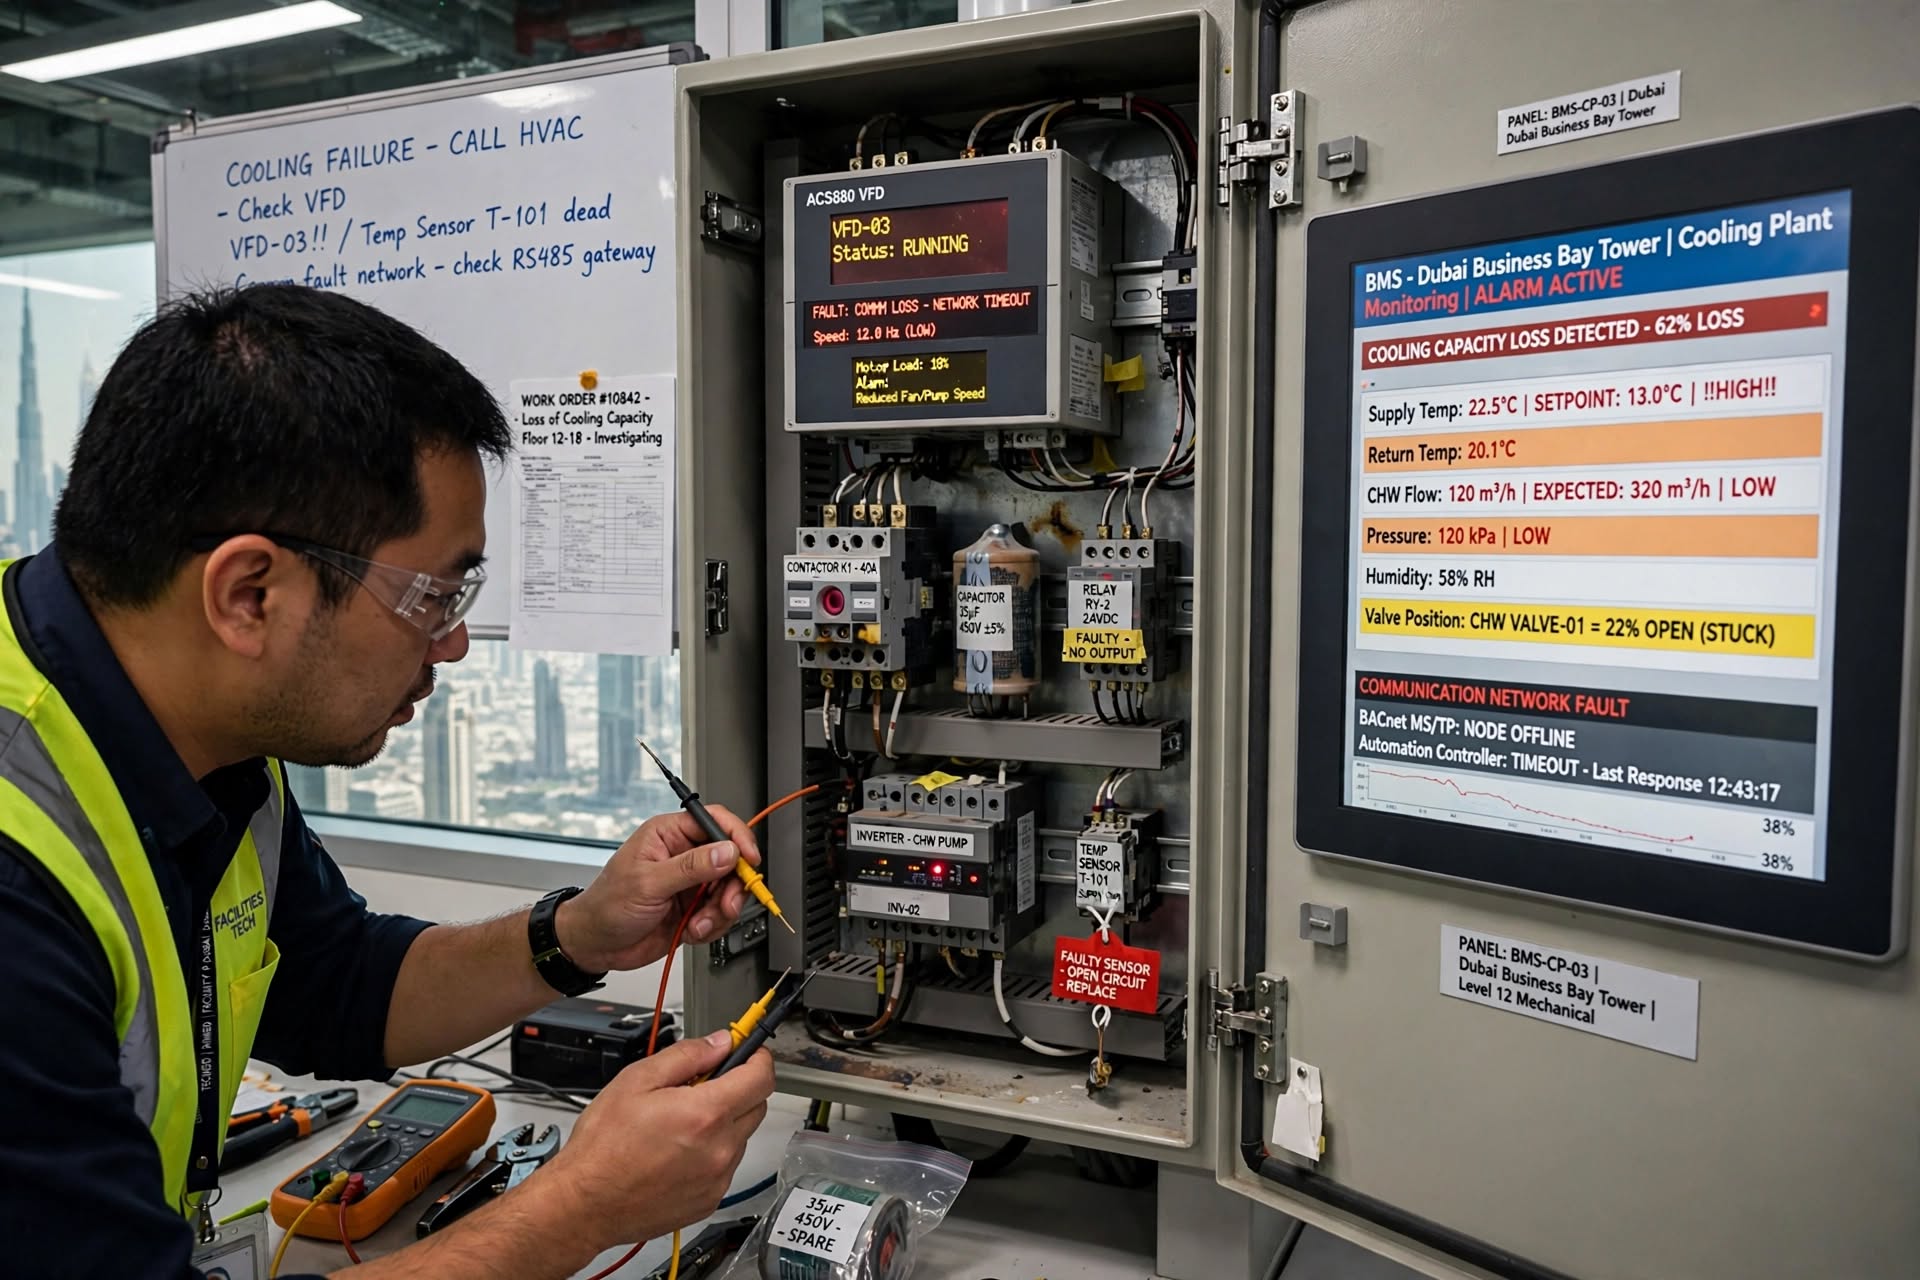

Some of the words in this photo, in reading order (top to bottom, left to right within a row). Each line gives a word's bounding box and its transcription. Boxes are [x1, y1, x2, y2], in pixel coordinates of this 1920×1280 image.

[1508, 110, 1548, 128] PANEL:
[1552, 93, 1616, 119] BMS-CP-03
[1627, 82, 1665, 102] Dubai
[1506, 127, 1537, 145] Dubai
[1541, 118, 1590, 138] Business
[1594, 113, 1615, 127] Bay
[1618, 105, 1656, 121] Tower
[226, 152, 312, 187] COOLING
[327, 136, 414, 171] FAILURE
[449, 126, 506, 155] CALL
[520, 116, 584, 144] HVAC
[238, 193, 293, 223] Check
[304, 187, 346, 213] VFD
[806, 189, 855, 207] ACS880
[859, 186, 885, 201] VFD
[230, 224, 327, 261] VFD-03!!
[361, 222, 406, 251] Temp
[417, 215, 475, 239] Sensor
[486, 202, 546, 230] T-101
[564, 193, 611, 221] dead
[832, 216, 890, 238] VFD-03
[832, 243, 895, 262] Status:
[903, 234, 969, 257] RUNNING
[1366, 269, 1402, 293] BMS
[1418, 259, 1467, 285] Dubai
[1473, 251, 1551, 278] Business
[1558, 244, 1593, 269] Bay
[1598, 235, 1661, 260] Tower
[1678, 219, 1763, 249] Cooling
[1770, 206, 1833, 237] Plant
[304, 264, 347, 289] fault
[358, 260, 425, 285] network
[453, 249, 503, 276] check
[513, 243, 574, 271] RS485
[583, 242, 656, 276] gateway
[1365, 289, 1458, 319] Monitoring
[1474, 276, 1543, 305] ALARM
[1548, 265, 1623, 295] ACTIVE
[813, 304, 849, 319] FAULT:
[892, 299, 919, 315] LOSS
[933, 295, 979, 312] NETWORK
[984, 292, 1031, 308] TIMEOUT
[813, 330, 849, 345] Speed:
[857, 326, 882, 340] 12.0
[886, 325, 899, 338] Hz
[905, 322, 936, 339] (LOW)
[1368, 342, 1431, 364] COOLING
[1434, 333, 1508, 357] CAPACITY
[1510, 328, 1550, 350] LOSS
[1554, 319, 1639, 345] DETECTED
[1655, 313, 1692, 335] 62%
[1697, 307, 1744, 331] LOSS
[856, 360, 889, 374] Motor
[893, 358, 923, 372] Load:
[930, 357, 949, 370] 18%
[856, 377, 889, 389] Alarm:
[521, 394, 555, 407] WORK
[559, 393, 596, 406] ORDER
[599, 391, 641, 405] #10842
[856, 390, 898, 404] Reduced
[901, 388, 949, 403] Fan/Pump
[954, 386, 985, 401] Speed
[1368, 402, 1415, 426] Supply
[1420, 402, 1462, 422] Temp:
[1468, 396, 1517, 416] 22.5°C
[1535, 389, 1620, 411] SETPOINT:
[1628, 384, 1682, 405] 13.0°C
[1704, 376, 1776, 400] !!HIGH!!
[522, 413, 545, 426] Loss
[549, 411, 561, 425] of
[563, 410, 603, 428] Cooling
[607, 410, 653, 428] Capacity
[522, 431, 548, 445] Floor
[552, 431, 582, 445] 12-18
[595, 430, 663, 447] Investigating
[1368, 446, 1414, 464] Return
[1419, 444, 1462, 465] Temp:
[1467, 439, 1516, 459] 20.1°C
[1367, 486, 1400, 504] CHW
[1405, 485, 1442, 503] Flow:
[1449, 484, 1475, 502] 120
[1479, 482, 1516, 503] m³/h
[1534, 481, 1623, 501] EXPECTED:
[1630, 479, 1662, 499] 320
[1667, 477, 1710, 500] m³/h
[1731, 476, 1776, 497] LOW
[1367, 526, 1431, 544] Pressure:
[1438, 527, 1464, 544] 120
[1469, 526, 1496, 544] kPa
[1513, 526, 1551, 545] LOW
[787, 561, 839, 573] CONTACTOR
[841, 562, 851, 573] K1
[1366, 567, 1432, 590] Humidity:
[1438, 568, 1468, 587] 58%
[1473, 570, 1495, 587] RH
[958, 591, 1005, 603] CAPACITOR
[1083, 584, 1117, 596] RELAY
[1086, 598, 1110, 610] RY-2
[984, 622, 1005, 635] ±5%
[1076, 632, 1119, 644] FAULTY
[1365, 607, 1400, 626] Valve
[1405, 608, 1465, 629] Position:
[1469, 612, 1506, 630] CHW
[1510, 613, 1584, 634] VALVE-01
[1605, 617, 1640, 639] 22%
[1644, 619, 1694, 642] OPEN
[1700, 622, 1775, 648] (STUCK)
[1069, 647, 1086, 658] NO
[1089, 647, 1136, 659] OUTPUT
[1359, 677, 1486, 704] COMMUNICATION
[1489, 689, 1571, 712] NETWORK
[1575, 694, 1630, 718] FAULT
[1359, 708, 1407, 729] BACnet
[1410, 713, 1460, 735] MS/TP:
[1463, 719, 1507, 741] NODE
[1510, 724, 1575, 749] OFFLINE
[1358, 733, 1432, 759] Automation
[1436, 743, 1507, 768] Controller:
[1510, 752, 1580, 777] TIMEOUT
[1592, 761, 1624, 783] Last
[1627, 766, 1703, 792] Response
[1707, 776, 1781, 802] 12:43:17
[1762, 818, 1795, 836] 38%
[856, 830, 904, 844] INVERTER
[913, 834, 936, 848] CHW
[938, 836, 968, 849] PUMP
[1080, 843, 1108, 856] TEMP
[1079, 857, 1120, 872] SENSOR
[1761, 852, 1794, 871] 38%
[1078, 872, 1108, 886] T-101
[214, 890, 264, 932] FACILITIES
[887, 902, 920, 916] INV-02
[230, 912, 256, 940] TECH
[1061, 950, 1102, 967] FAULTY
[1104, 957, 1151, 976] SENSOR
[1459, 936, 1506, 960] PANEL:
[1511, 947, 1589, 979] BMS-CP-03
[1067, 965, 1099, 982] OPEN
[1101, 972, 1147, 990] CIRCUIT
[1459, 956, 1497, 979] Dubai
[1502, 966, 1563, 994] Business
[1567, 982, 1594, 1006] Bay
[1599, 989, 1647, 1015] Tower
[1066, 979, 1117, 1000] REPLACE
[1459, 977, 1492, 998] Level
[1496, 987, 1512, 1003] 12
[1516, 992, 1595, 1024] Mechanical
[806, 1197, 845, 1215] 35µF
[794, 1212, 834, 1231] 450V
[787, 1228, 836, 1253] SPARE
